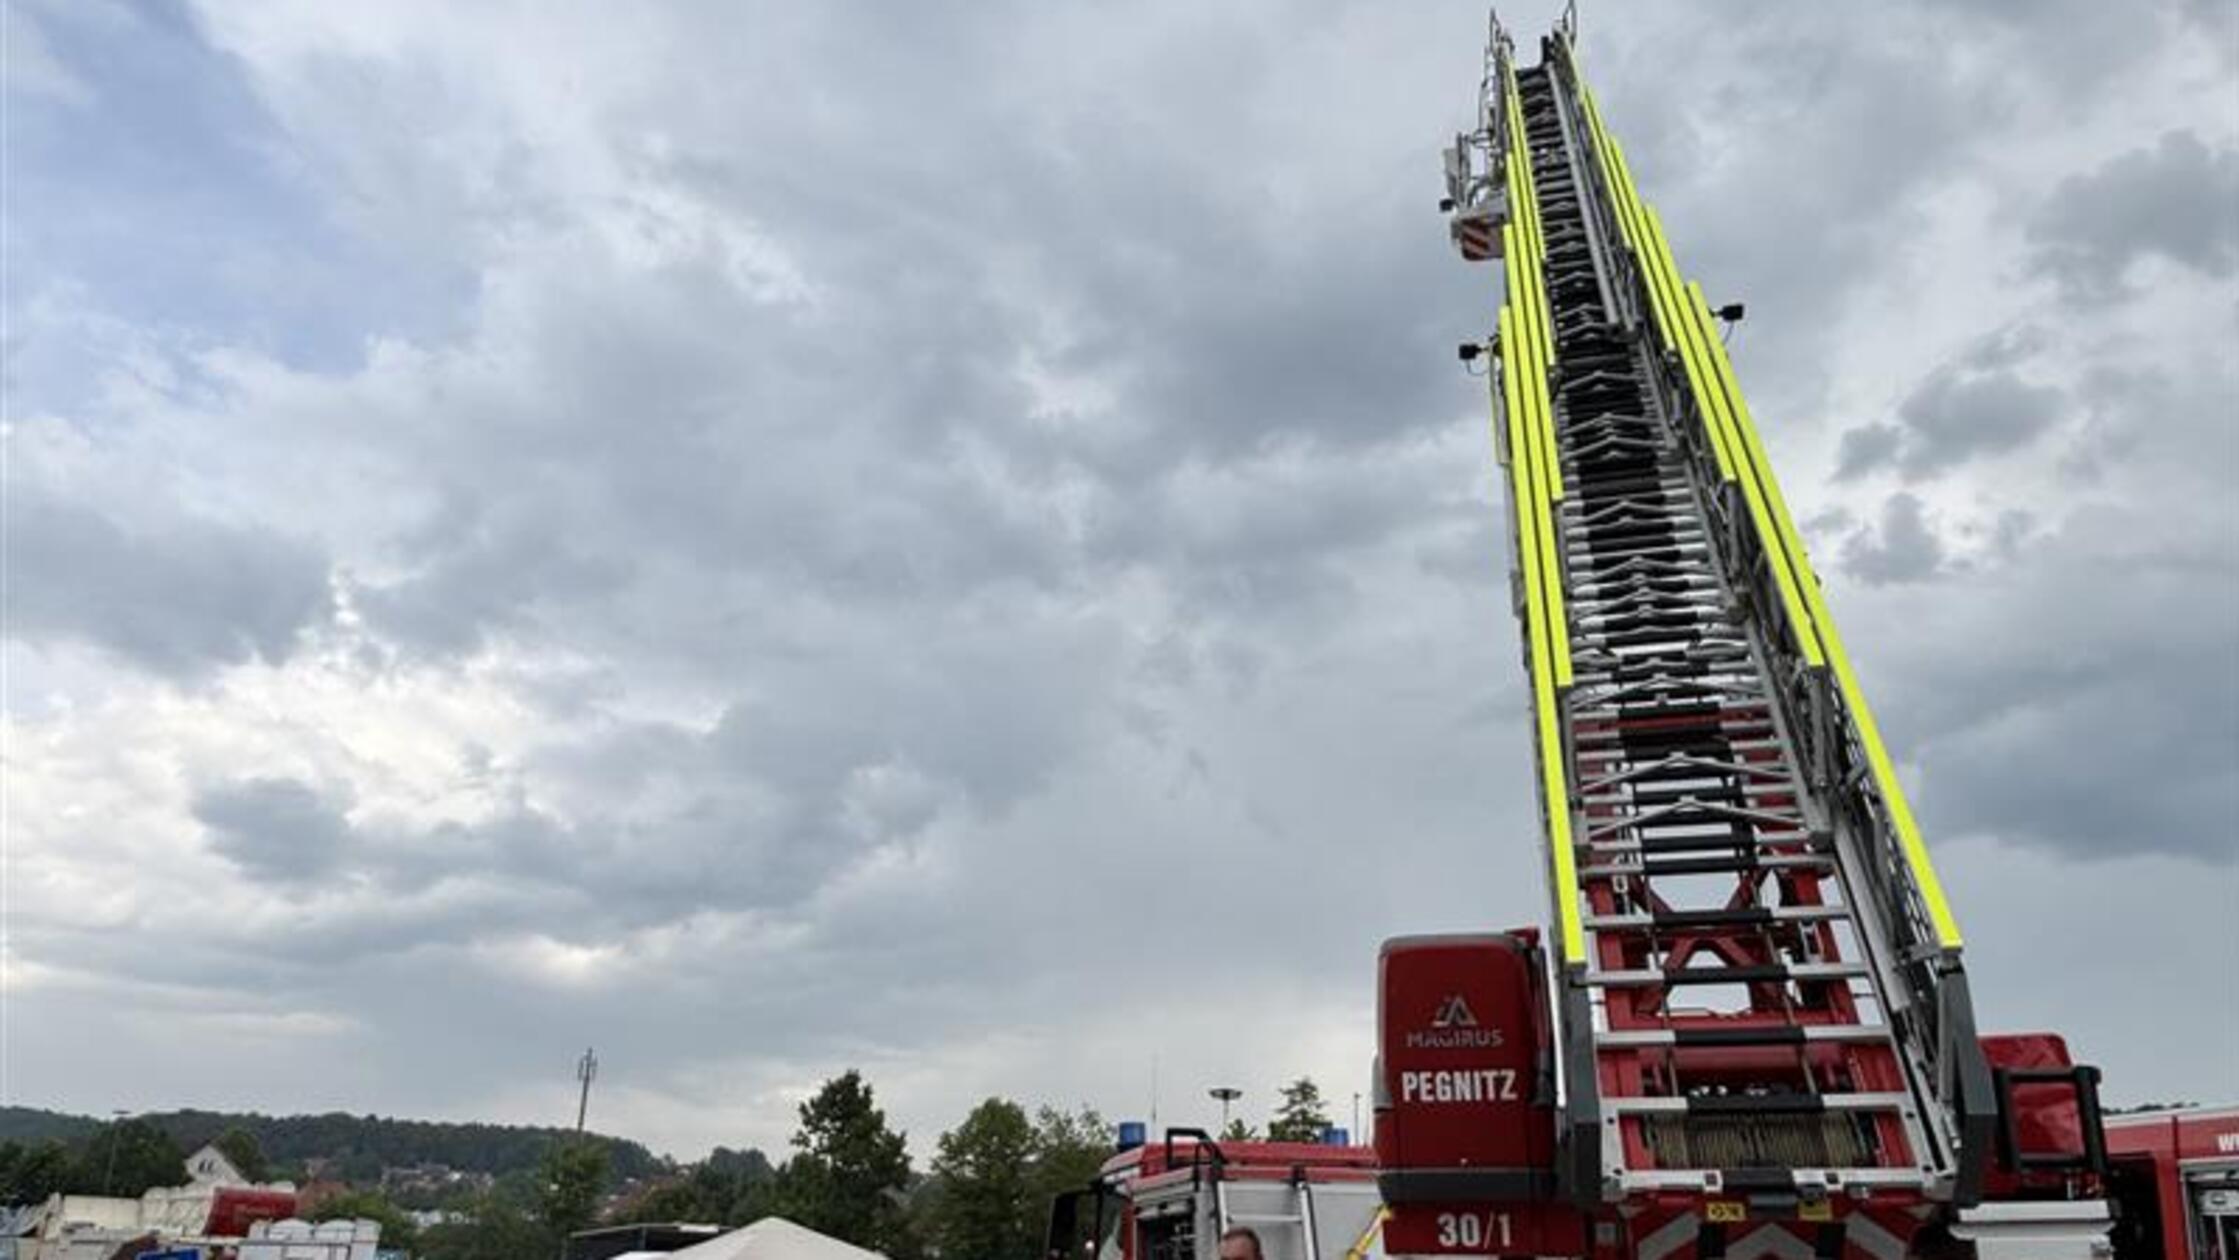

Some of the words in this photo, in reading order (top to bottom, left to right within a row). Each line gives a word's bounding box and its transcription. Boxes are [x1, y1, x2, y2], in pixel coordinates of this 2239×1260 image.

[1407, 1029, 1504, 1048] MAGIRUS
[1401, 1070, 1518, 1101] PEGNITZ
[1437, 1212, 1510, 1249] 30/1
